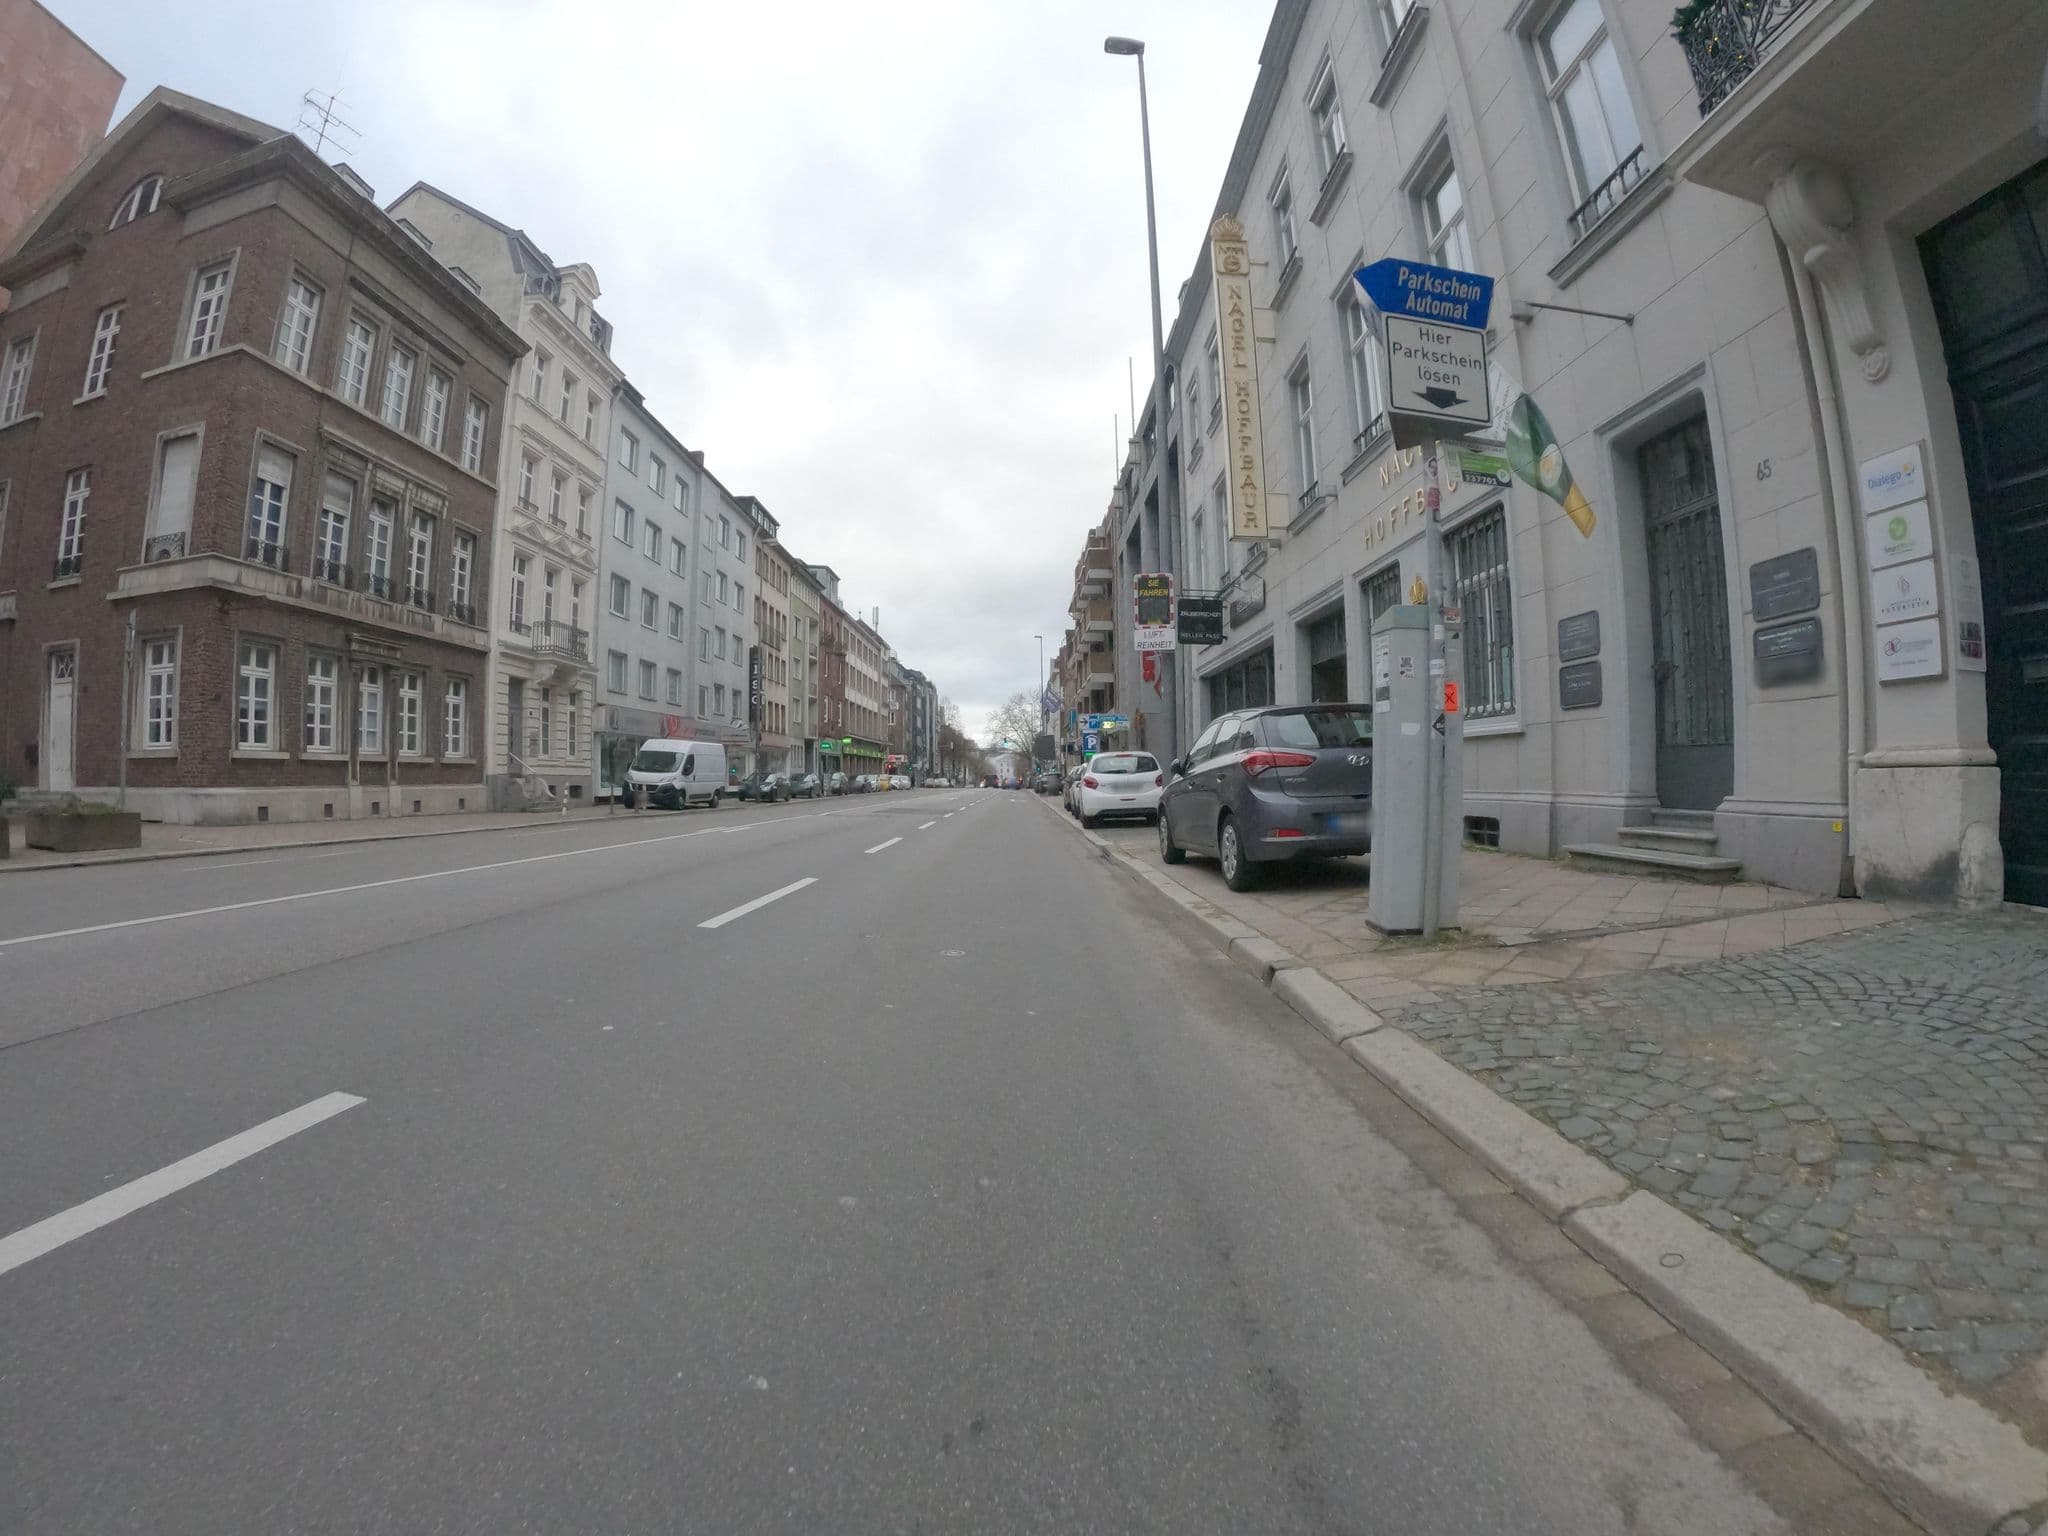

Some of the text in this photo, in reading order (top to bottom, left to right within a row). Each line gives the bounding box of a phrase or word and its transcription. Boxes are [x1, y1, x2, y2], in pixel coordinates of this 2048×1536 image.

[1398, 267, 1481, 301] Parkschein
[1405, 292, 1469, 321] Automat
[1419, 327, 1452, 346] Hier
[1392, 342, 1483, 371] Parkschein
[1418, 366, 1461, 386] lösen
[1756, 458, 1773, 482] 65
[1139, 588, 1169, 597] FAHREN
[1147, 579, 1160, 587] SIE
[1136, 641, 1172, 649] REINHEIT
